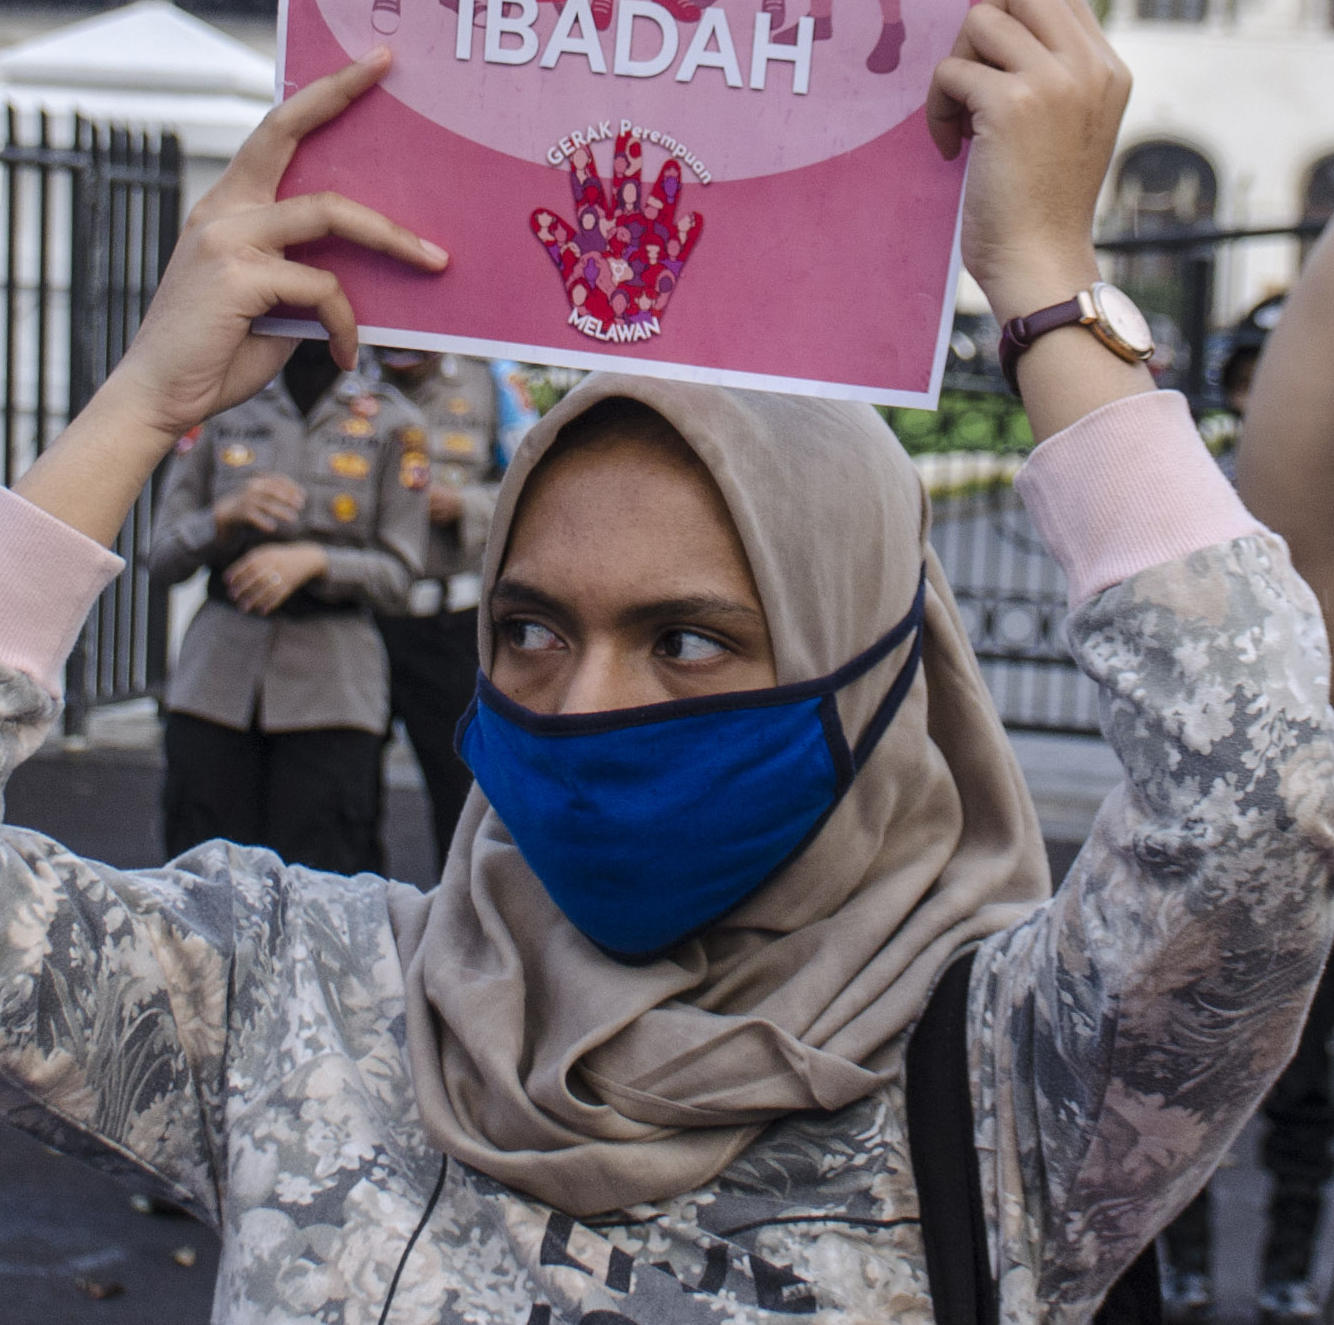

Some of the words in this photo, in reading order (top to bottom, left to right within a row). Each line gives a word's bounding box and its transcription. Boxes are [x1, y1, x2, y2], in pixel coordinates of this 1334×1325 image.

[546, 120, 613, 166] GERAK
[620, 119, 712, 184] Perempuan
[567, 307, 661, 342] MELAWAN
